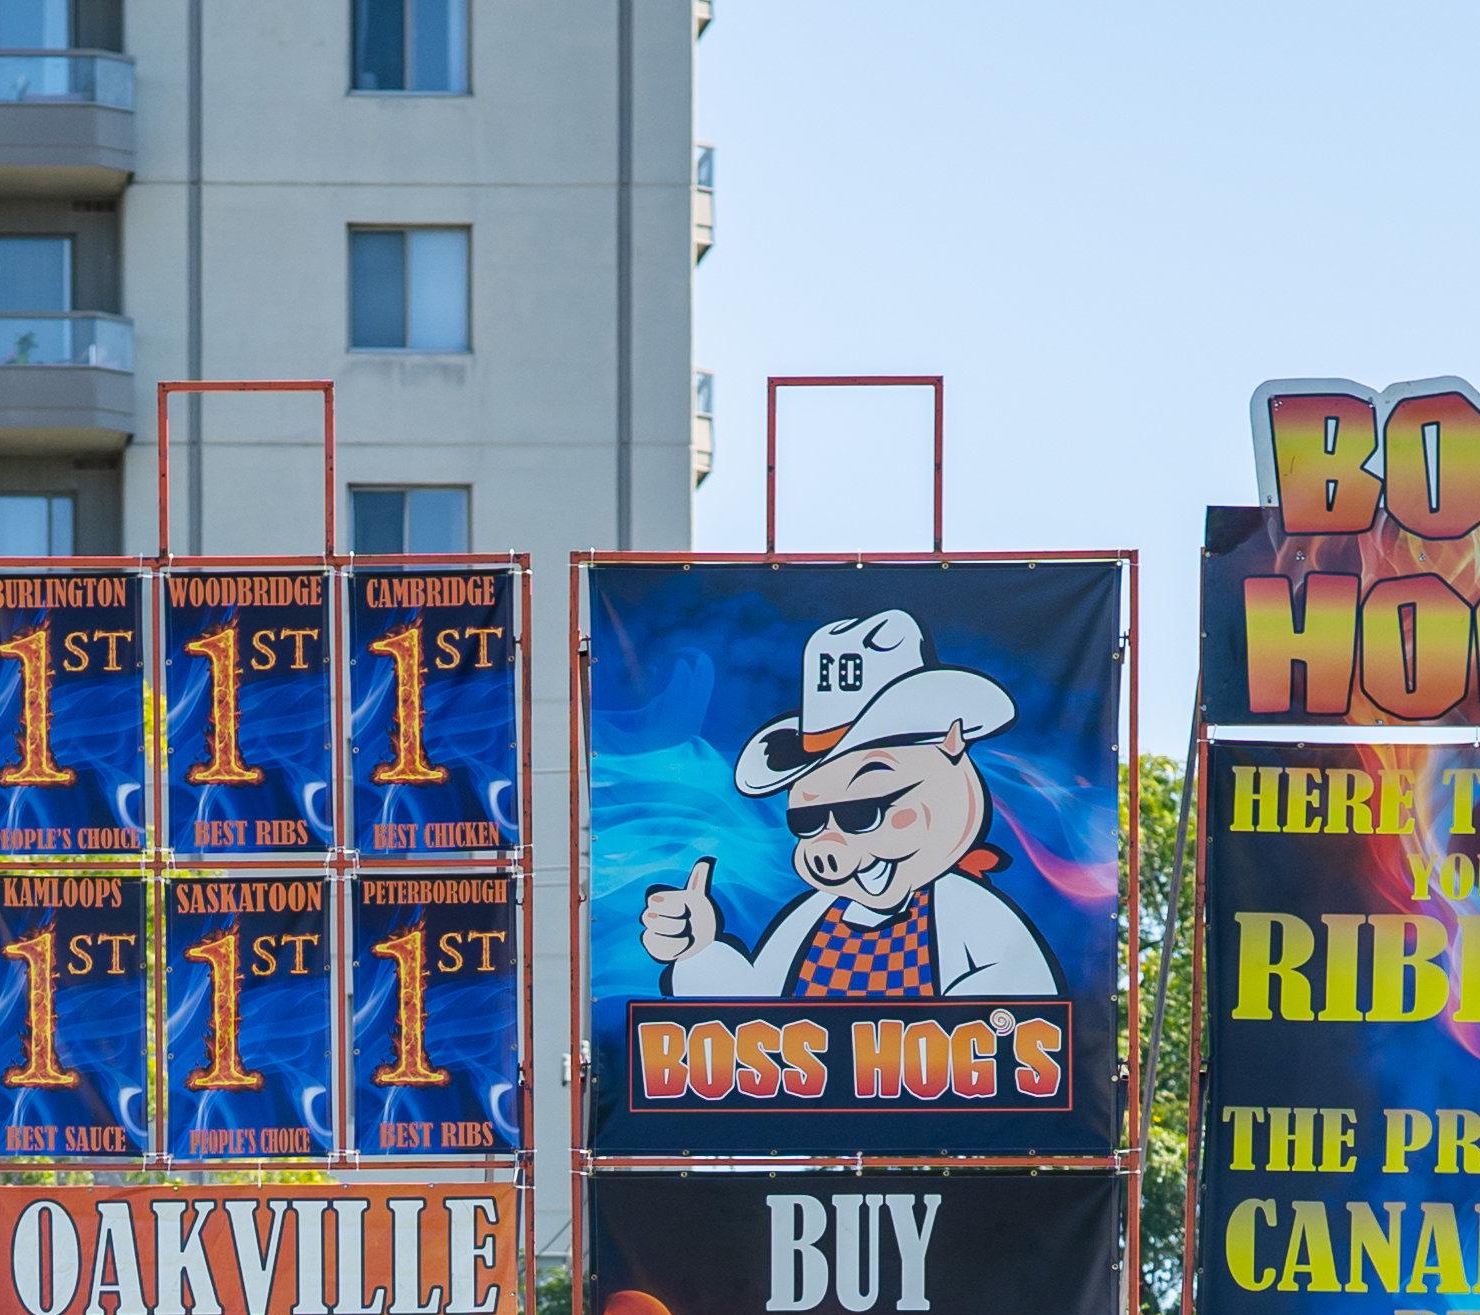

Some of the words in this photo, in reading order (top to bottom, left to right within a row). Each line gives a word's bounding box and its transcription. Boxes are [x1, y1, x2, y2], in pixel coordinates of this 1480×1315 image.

[1230, 765, 1416, 836] HERE
[638, 1019, 828, 1099] BOSS
[853, 1008, 1061, 1099] HOG'S
[1223, 1107, 1357, 1172] THE
[765, 1193, 942, 1313] BUY
